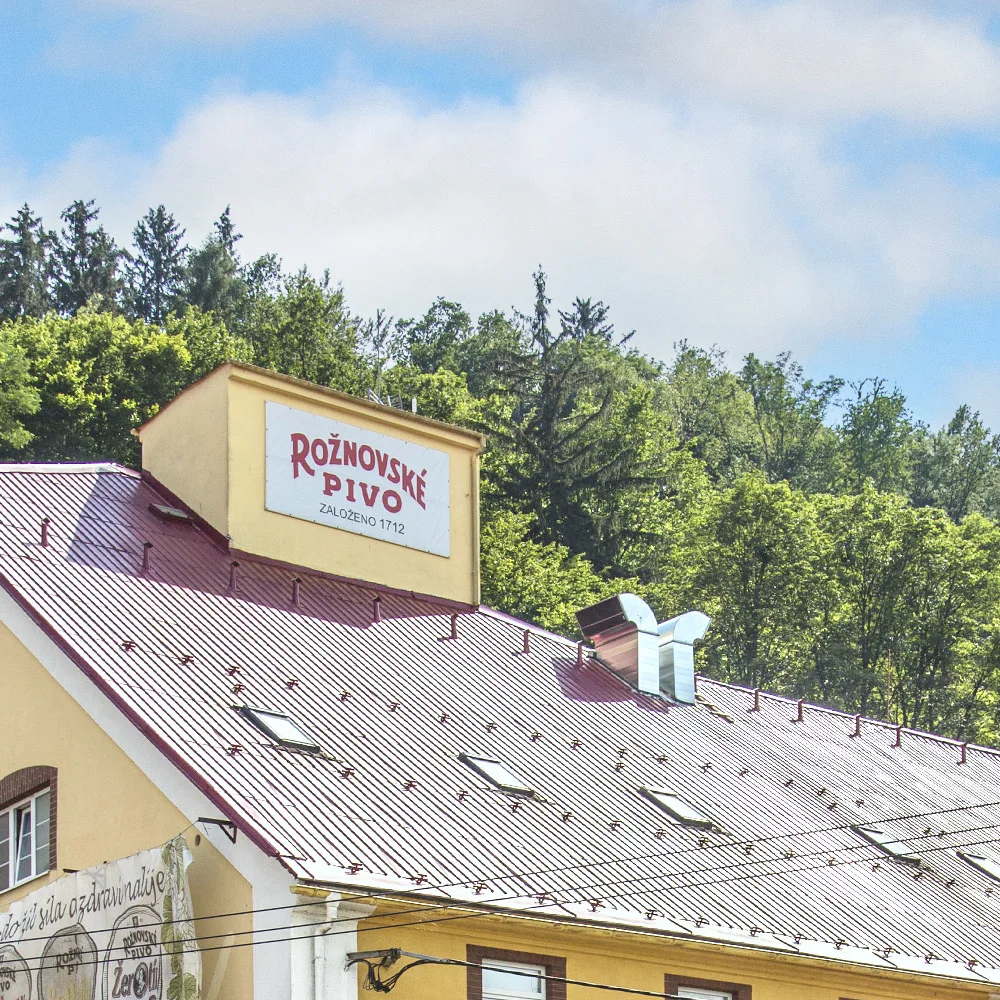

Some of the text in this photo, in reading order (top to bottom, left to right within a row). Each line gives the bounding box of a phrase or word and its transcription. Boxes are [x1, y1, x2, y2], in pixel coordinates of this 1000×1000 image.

[291, 432, 428, 510] ROŽNOVSKÉ
[322, 472, 403, 514] PIVO
[319, 503, 405, 535] ZALOŽENO 1712
